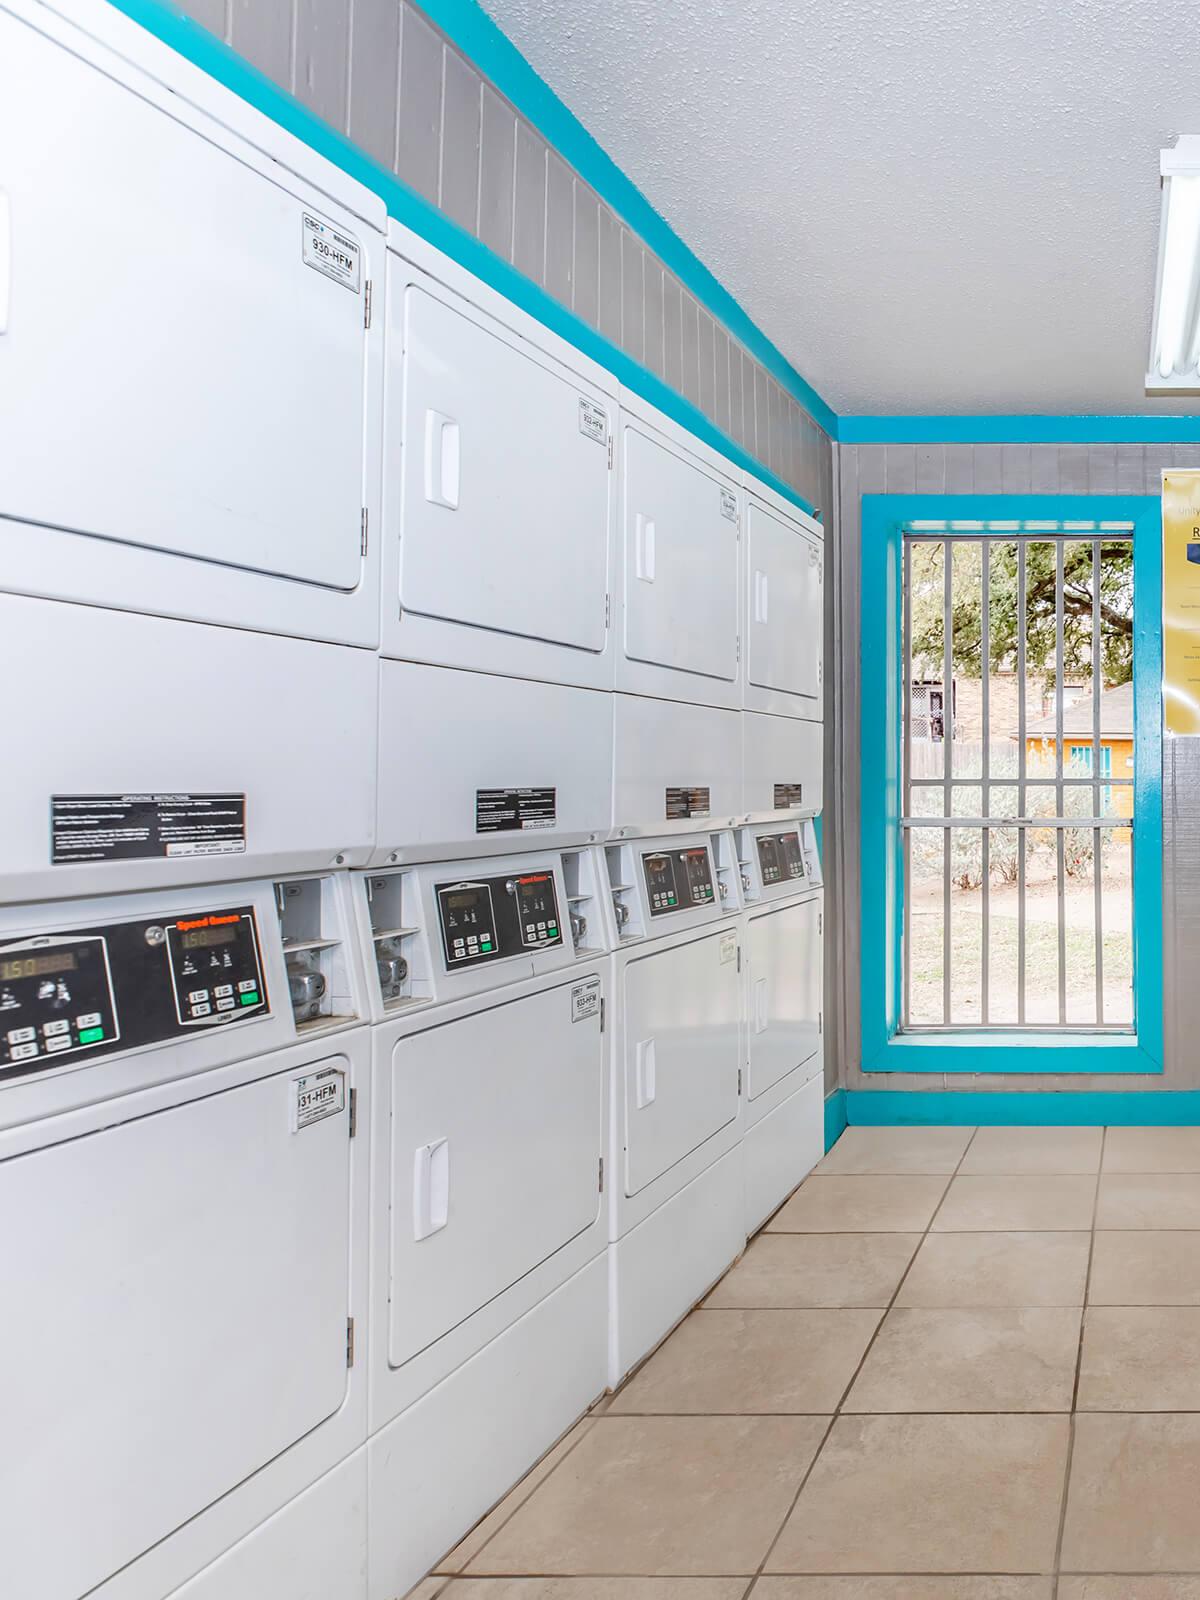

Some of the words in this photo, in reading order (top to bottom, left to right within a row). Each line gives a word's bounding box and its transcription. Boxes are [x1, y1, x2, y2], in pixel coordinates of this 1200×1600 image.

[304, 217, 319, 230] CSC
[312, 238, 353, 271] 930-HFM
[176, 917, 208, 931] Speed
[209, 914, 240, 926] Queen
